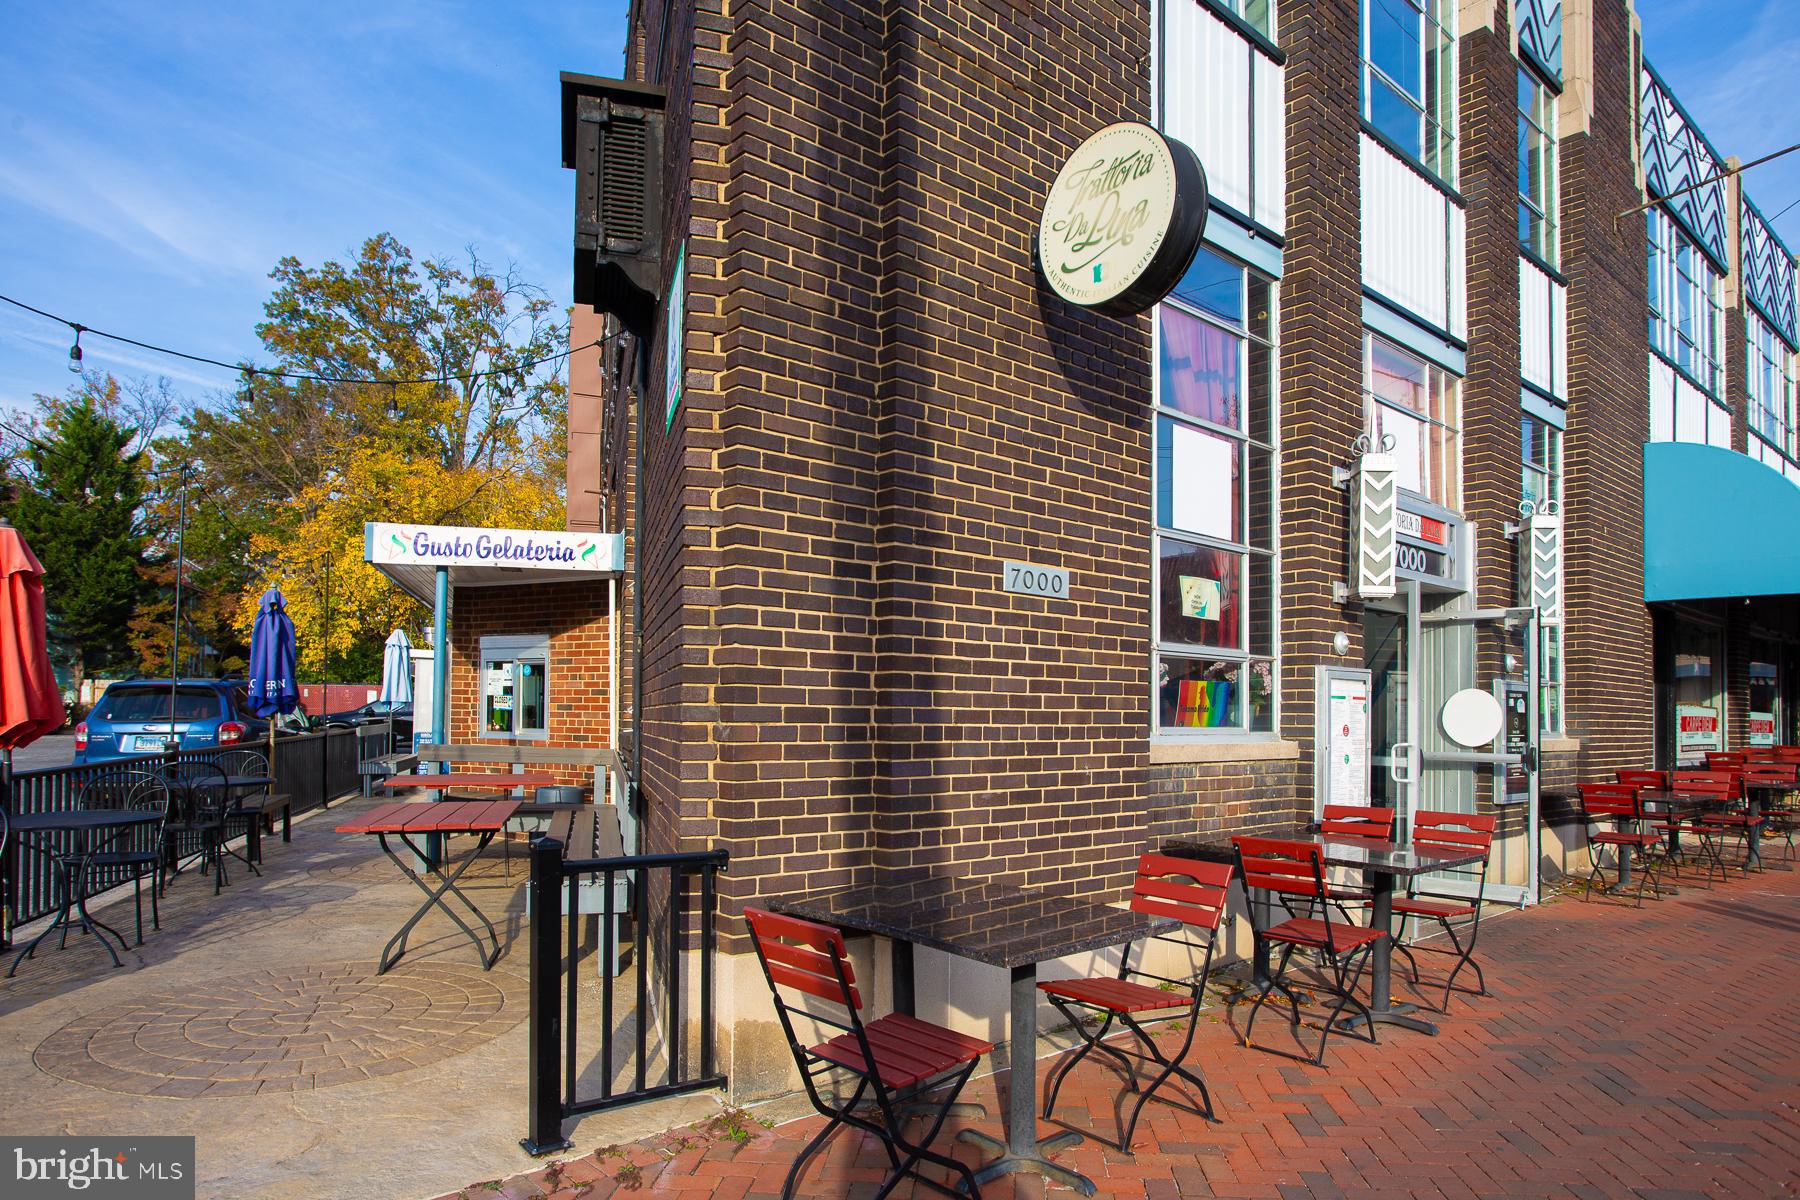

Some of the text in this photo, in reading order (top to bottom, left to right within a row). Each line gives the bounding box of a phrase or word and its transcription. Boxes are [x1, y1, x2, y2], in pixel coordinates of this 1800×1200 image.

[1065, 149, 1155, 215] Trattoria
[1052, 211, 1089, 243] Da
[1048, 270, 1089, 298] AUTHENTIC
[1131, 230, 1164, 276] CUISINE
[413, 532, 577, 562] Gusto Gelateria
[1011, 567, 1063, 593] 7000
